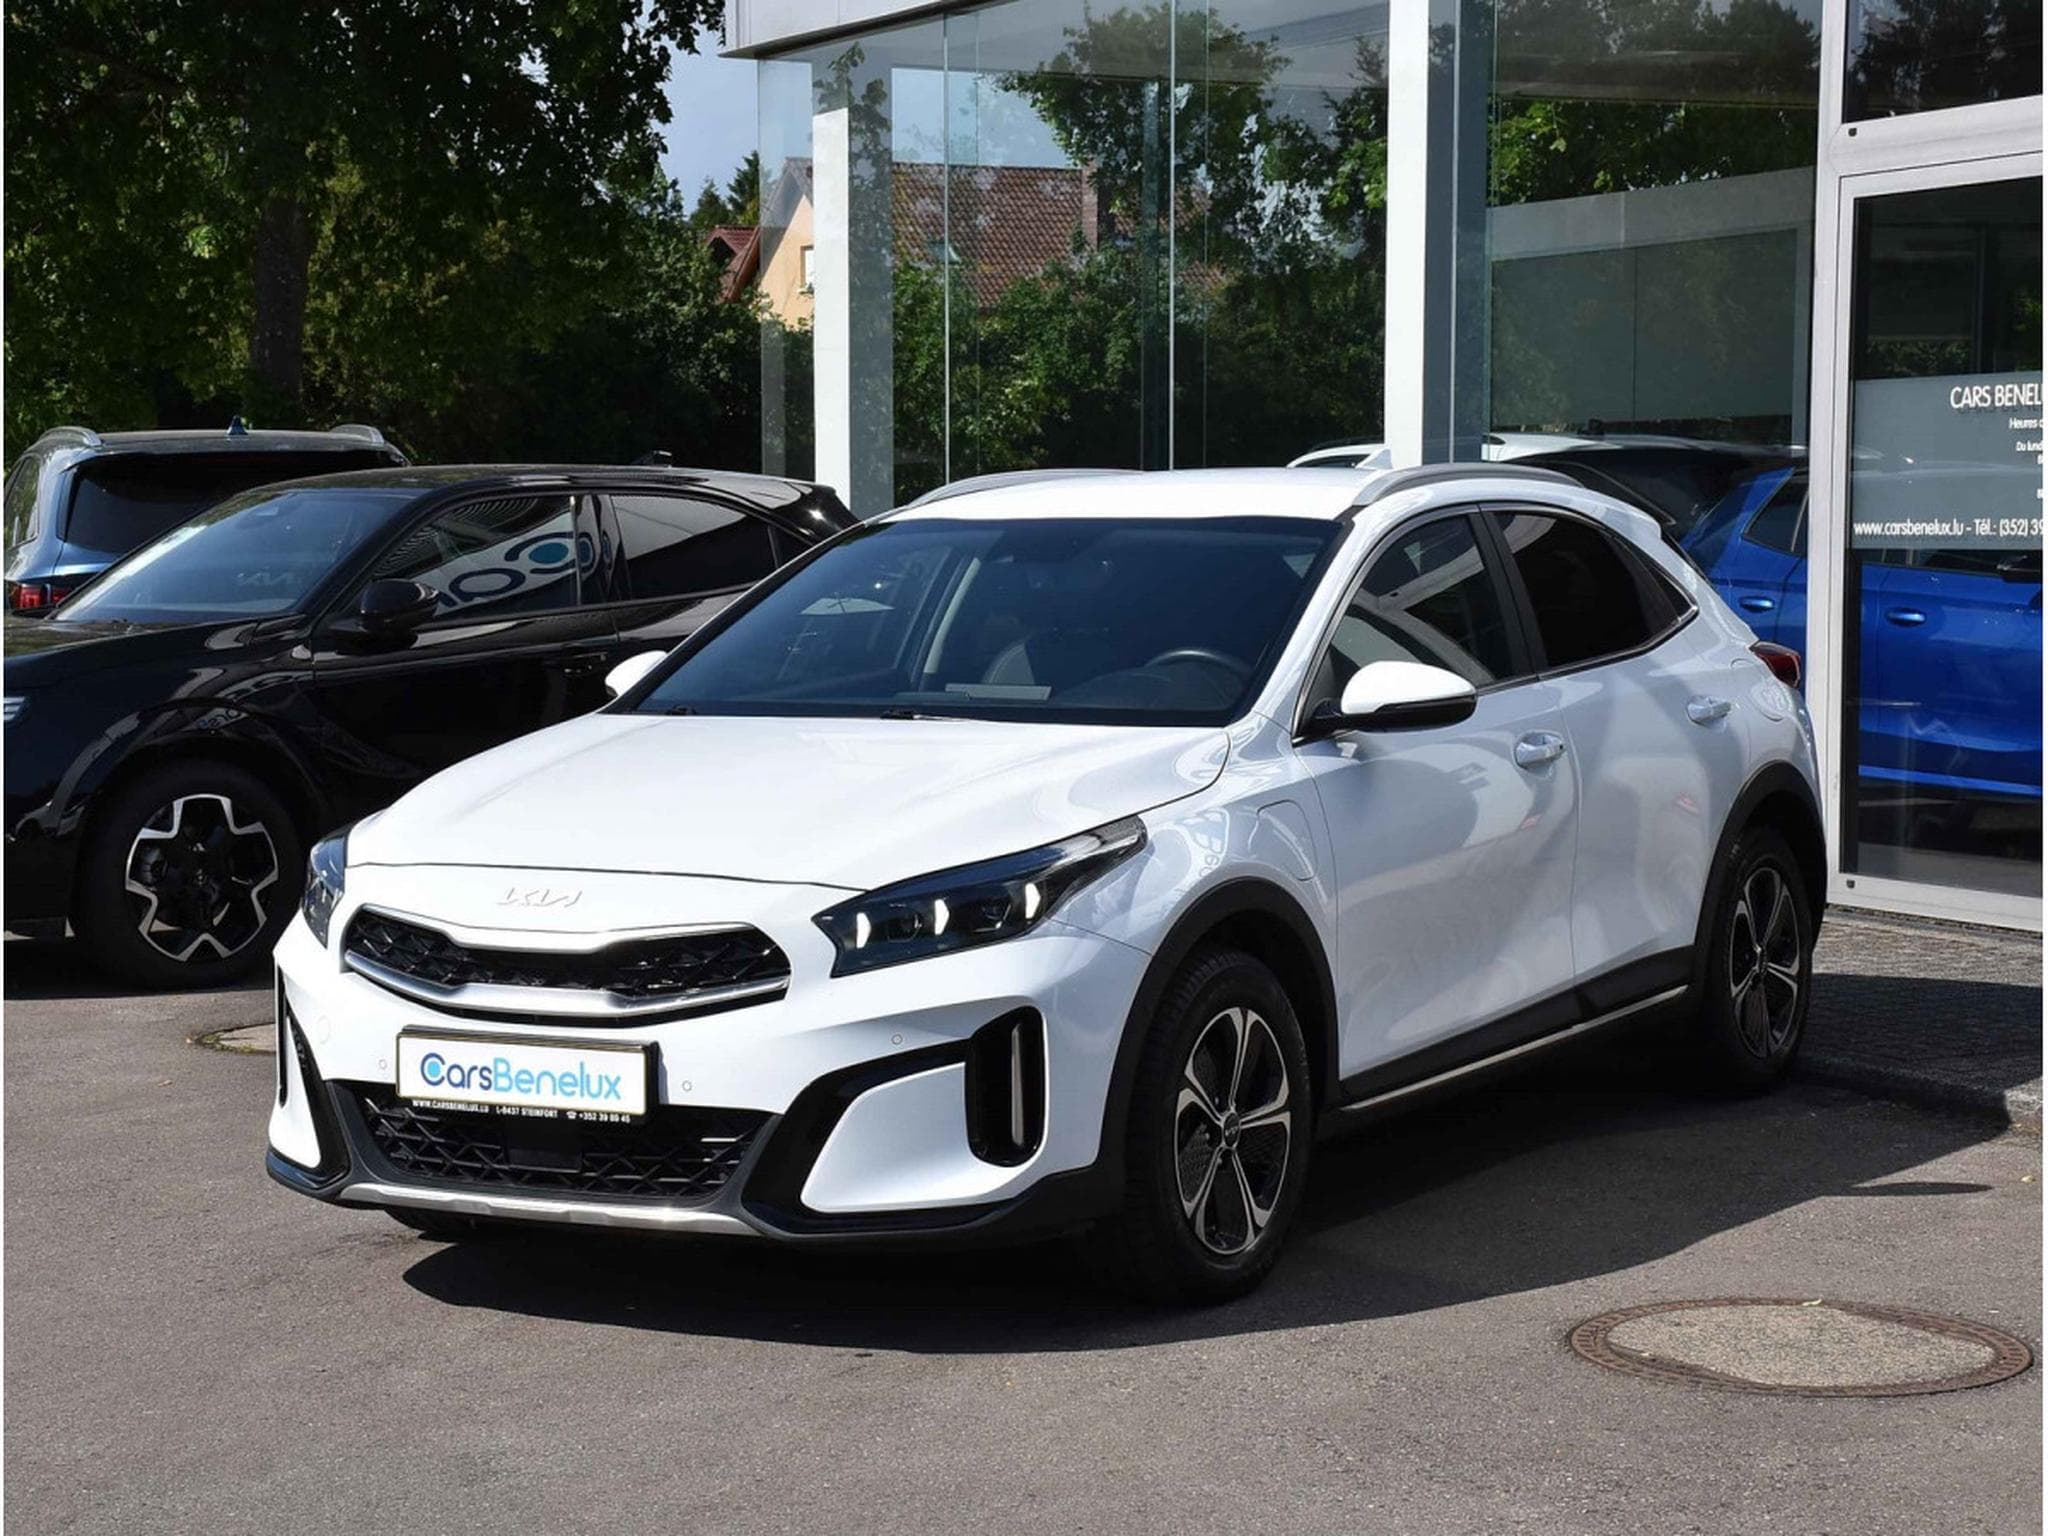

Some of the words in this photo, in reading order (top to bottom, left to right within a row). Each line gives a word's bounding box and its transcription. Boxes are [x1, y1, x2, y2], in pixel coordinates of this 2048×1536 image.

[1950, 385, 1992, 409] CARS
[1995, 382, 2043, 407] BENEL
[1853, 518, 1964, 536] www.carsbenelux.lu
[1999, 518, 2028, 537] (352)
[420, 1052, 621, 1100] CarsBenelux
